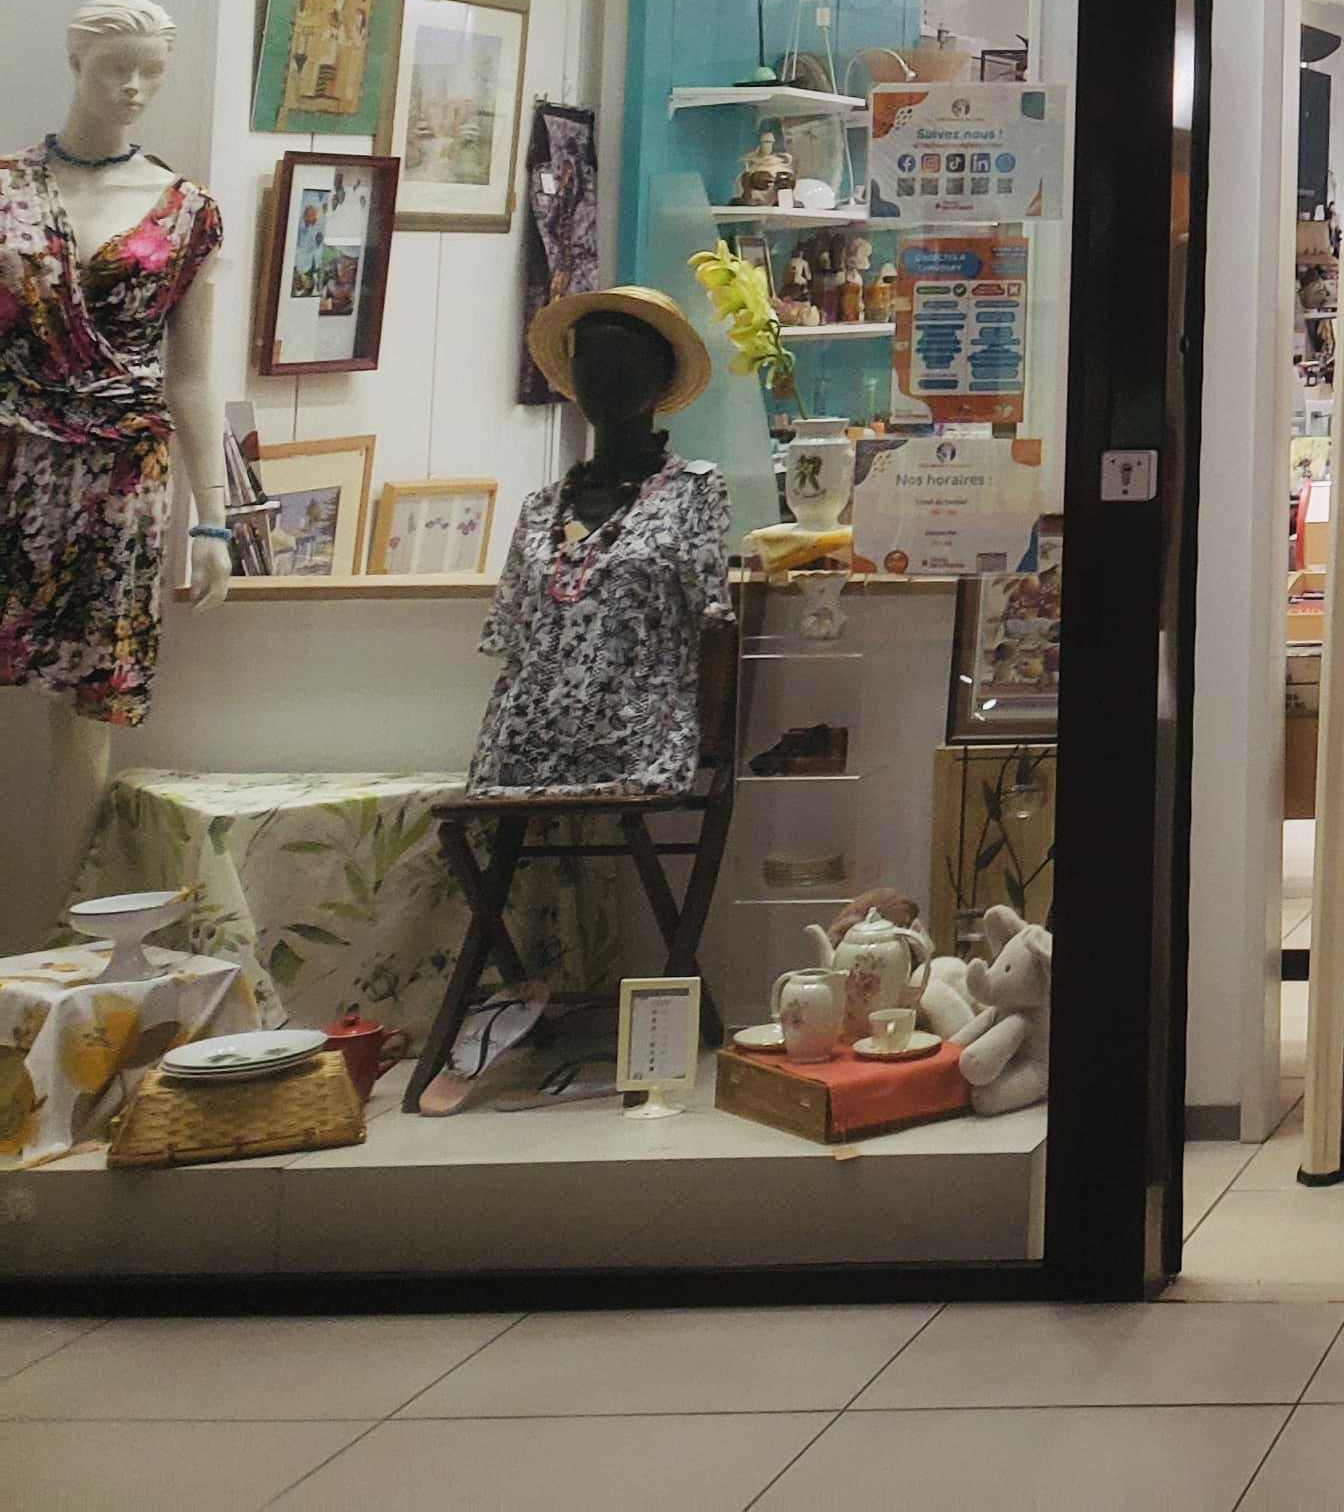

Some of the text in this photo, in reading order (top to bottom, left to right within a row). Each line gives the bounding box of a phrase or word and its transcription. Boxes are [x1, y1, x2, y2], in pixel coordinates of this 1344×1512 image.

[917, 128, 959, 139] Suivez
[964, 128, 995, 139] nous
[896, 473, 923, 487] Nos
[927, 473, 985, 487] horaires
